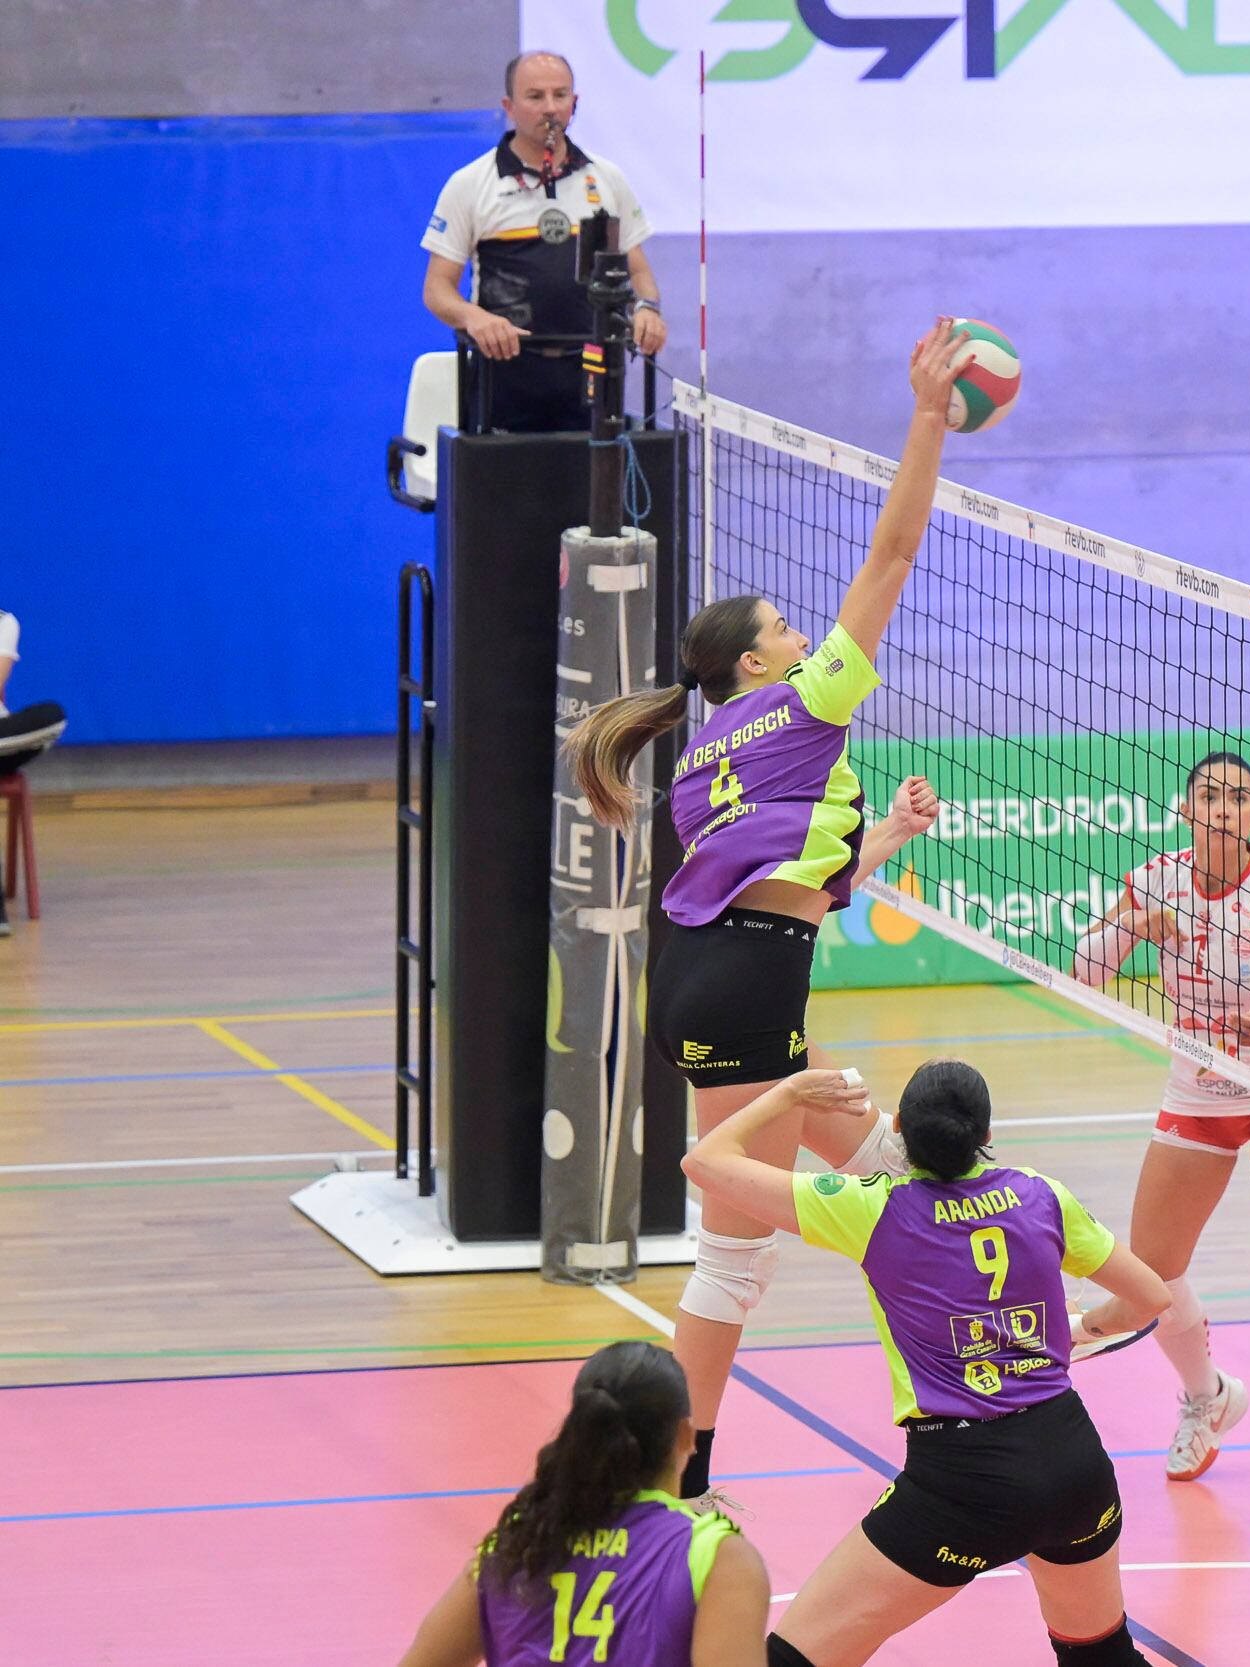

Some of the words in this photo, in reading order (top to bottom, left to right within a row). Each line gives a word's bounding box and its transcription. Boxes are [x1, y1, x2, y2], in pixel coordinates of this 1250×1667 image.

[1063, 526, 1107, 558] rfevb.com
[1175, 565, 1220, 599] rfevb.com
[693, 736, 728, 768] DEN
[731, 704, 792, 750] BOSCH
[709, 756, 744, 809] 4
[742, 920, 774, 931] TECHFIT
[694, 1060, 741, 1070] CANTERAS
[934, 1186, 1023, 1224] ARANDA
[969, 1226, 1009, 1302] 9
[916, 1422, 944, 1432] TECHFIT
[548, 1570, 618, 1664] 14
